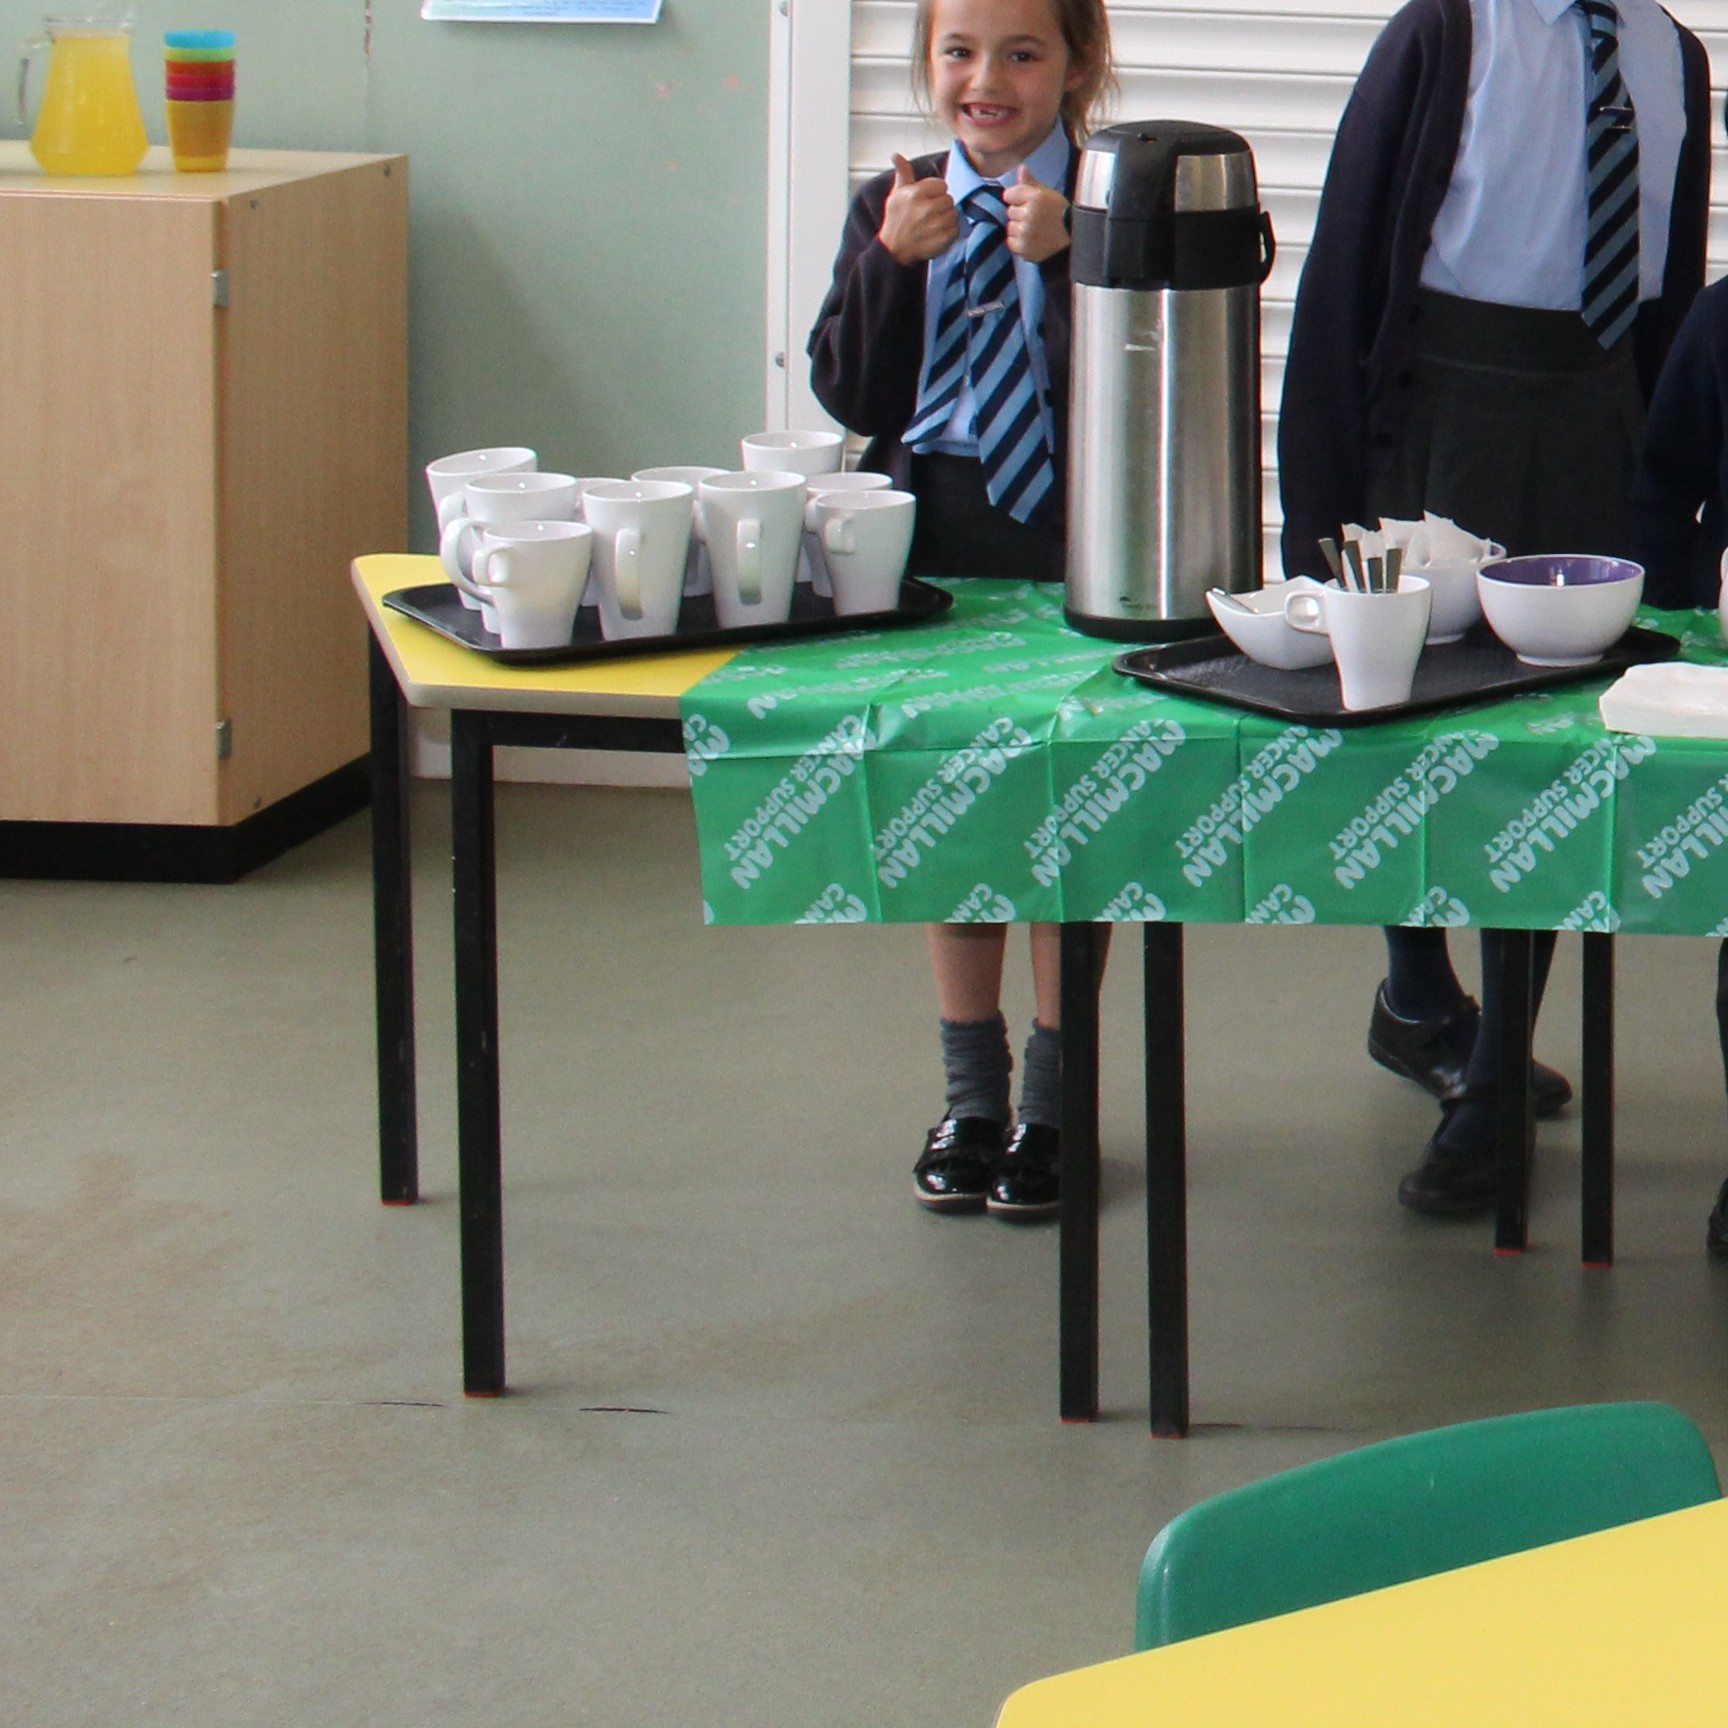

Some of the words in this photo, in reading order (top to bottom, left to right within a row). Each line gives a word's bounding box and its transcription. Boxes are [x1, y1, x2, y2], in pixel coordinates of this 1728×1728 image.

[724, 777, 796, 861] SUPPORT
[731, 724, 877, 889] MACMILLAN
[877, 727, 1032, 889] MACMILLAN
[1023, 774, 1098, 859] SUPPORT
[1031, 719, 1187, 887] MACMILLAN
[1175, 774, 1250, 859] SUPPORT
[1182, 728, 1343, 887] MACMILLAN
[1328, 776, 1411, 861] SUPPORT
[1334, 730, 1499, 890] MACMILLAN
[1483, 780, 1568, 863] SUPPORT
[1489, 735, 1656, 893] MACMILLAN
[1637, 786, 1722, 870] SUPPORT
